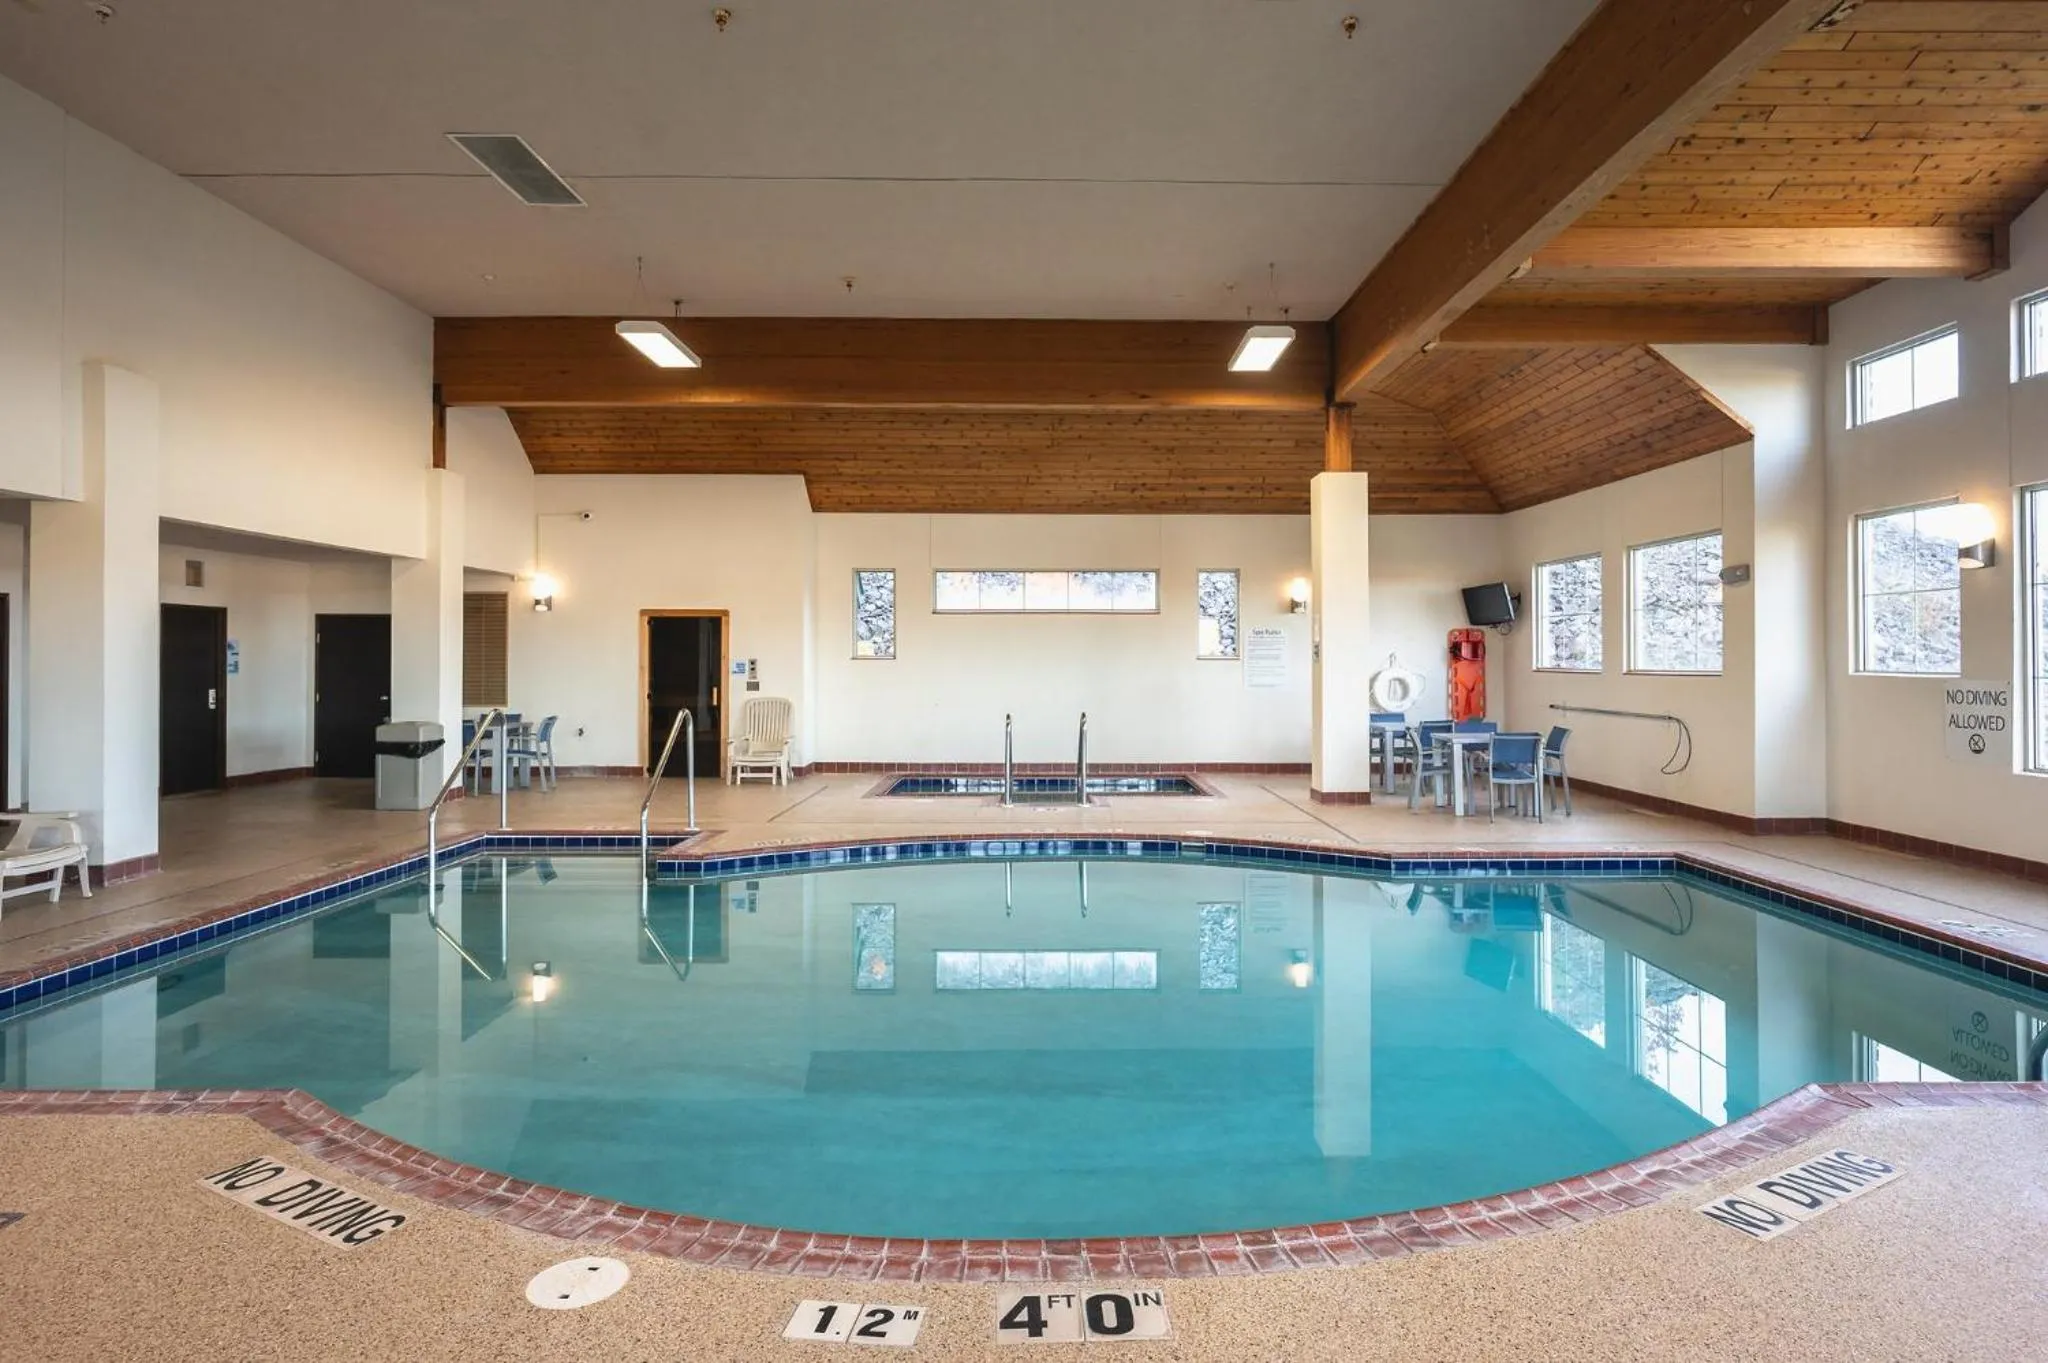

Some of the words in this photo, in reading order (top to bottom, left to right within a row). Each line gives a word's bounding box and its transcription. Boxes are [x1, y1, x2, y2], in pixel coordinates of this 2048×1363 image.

[1946, 689, 1964, 705] NO
[1966, 689, 2007, 706] DIVING
[1948, 713, 2005, 731] ALLOWED
[204, 1157, 285, 1191] NO
[254, 1179, 406, 1246] DIVING
[1702, 1199, 1784, 1238] NO
[1757, 1150, 1894, 1210] DIVING
